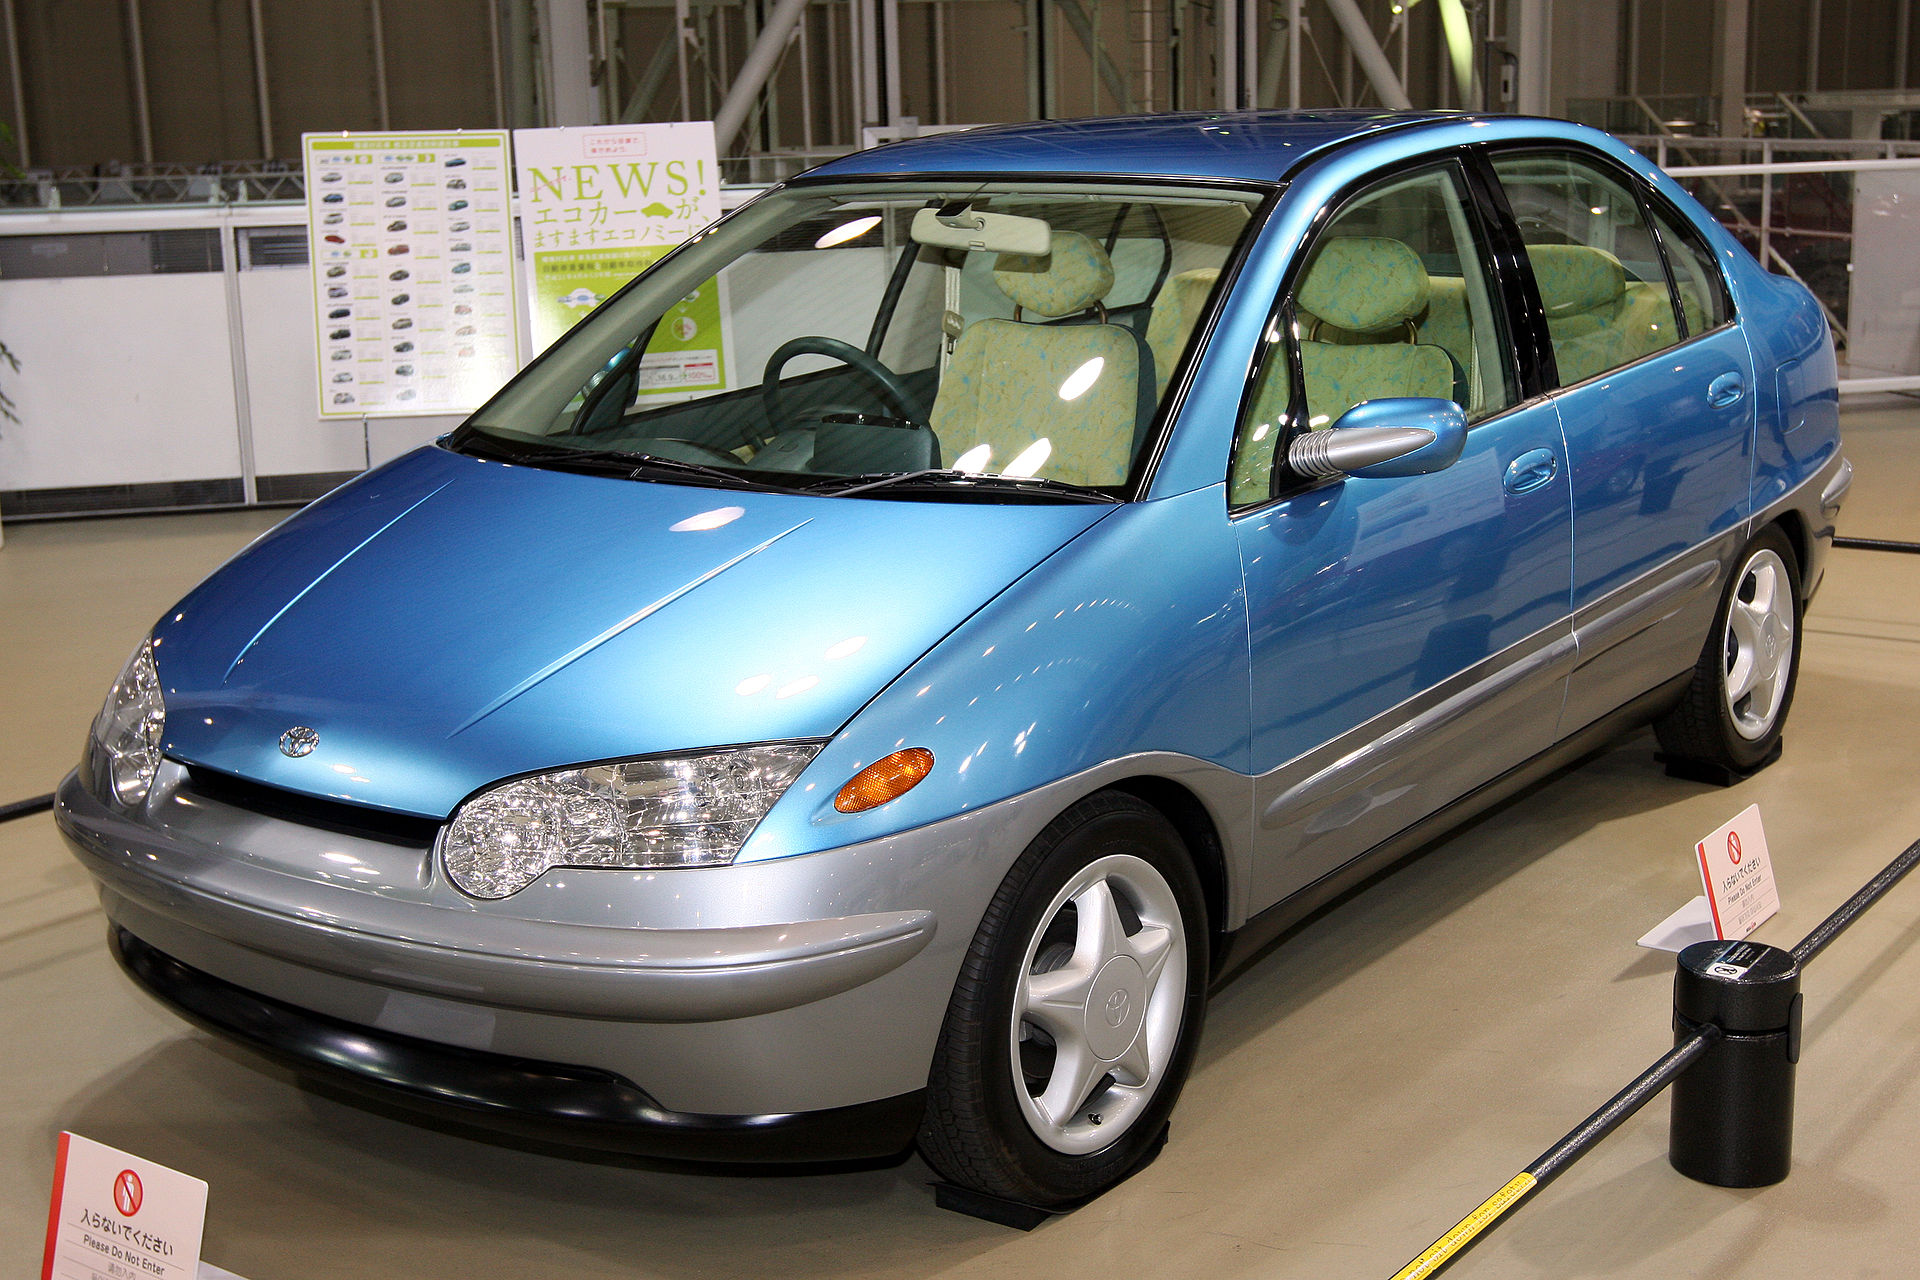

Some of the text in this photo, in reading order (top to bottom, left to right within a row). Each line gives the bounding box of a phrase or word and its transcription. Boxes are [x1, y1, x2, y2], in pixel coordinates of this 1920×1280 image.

[527, 159, 707, 203] NEWS!
[533, 201, 638, 226] エコカー
[1722, 857, 1761, 893] 入らないでください
[80, 1208, 173, 1256] 入らないでください
[1446, 1223, 1475, 1247] down
[1472, 1208, 1492, 1224] for
[83, 1233, 166, 1276] Please Do Not Enter
